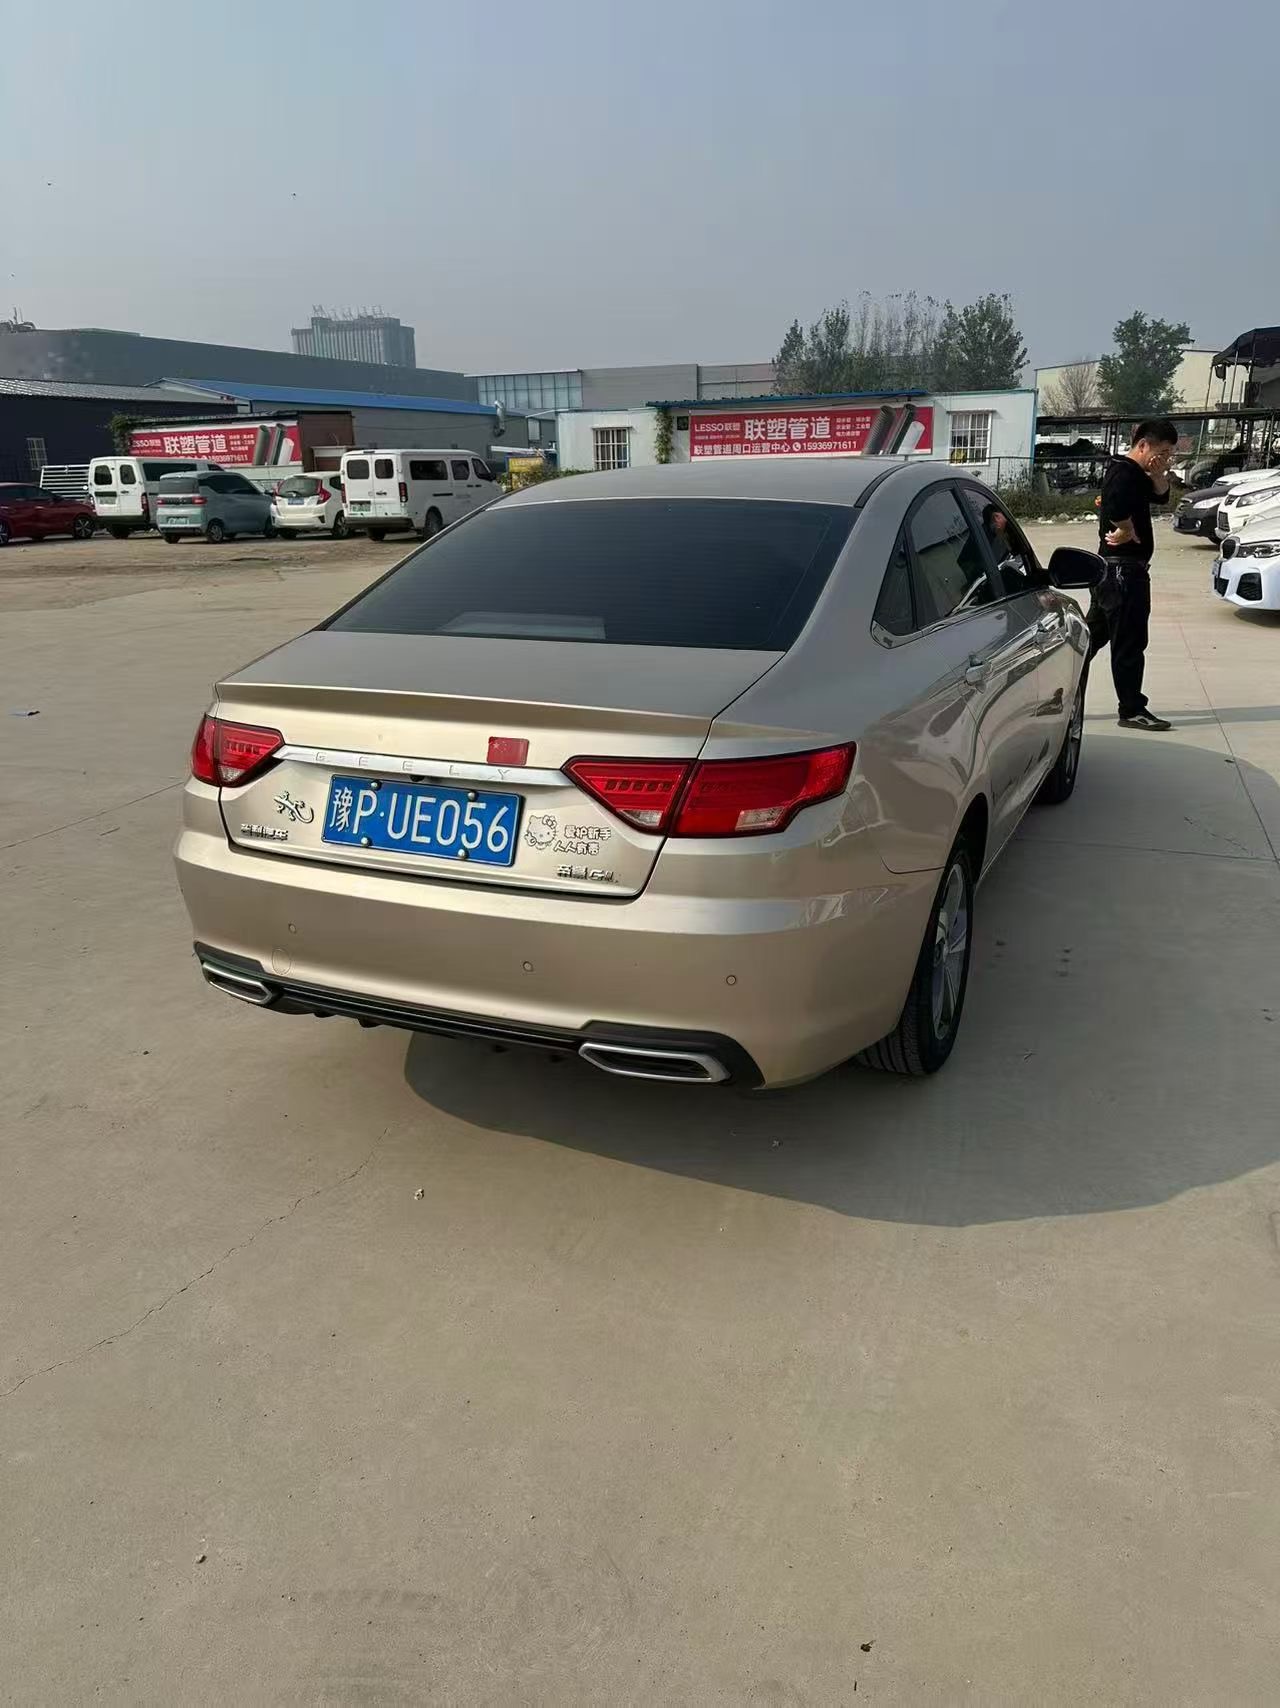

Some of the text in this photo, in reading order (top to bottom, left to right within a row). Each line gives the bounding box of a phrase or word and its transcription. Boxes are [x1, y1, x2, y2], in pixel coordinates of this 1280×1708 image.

[744, 416, 831, 441] 联塑管道
[163, 434, 228, 455] 联塑管道
[693, 441, 857, 456] 联塑管道周口运营中心 15936971611
[315, 751, 510, 781] GEELY
[329, 785, 509, 853] 豫P·UE056
[564, 825, 612, 840] 爱护新手
